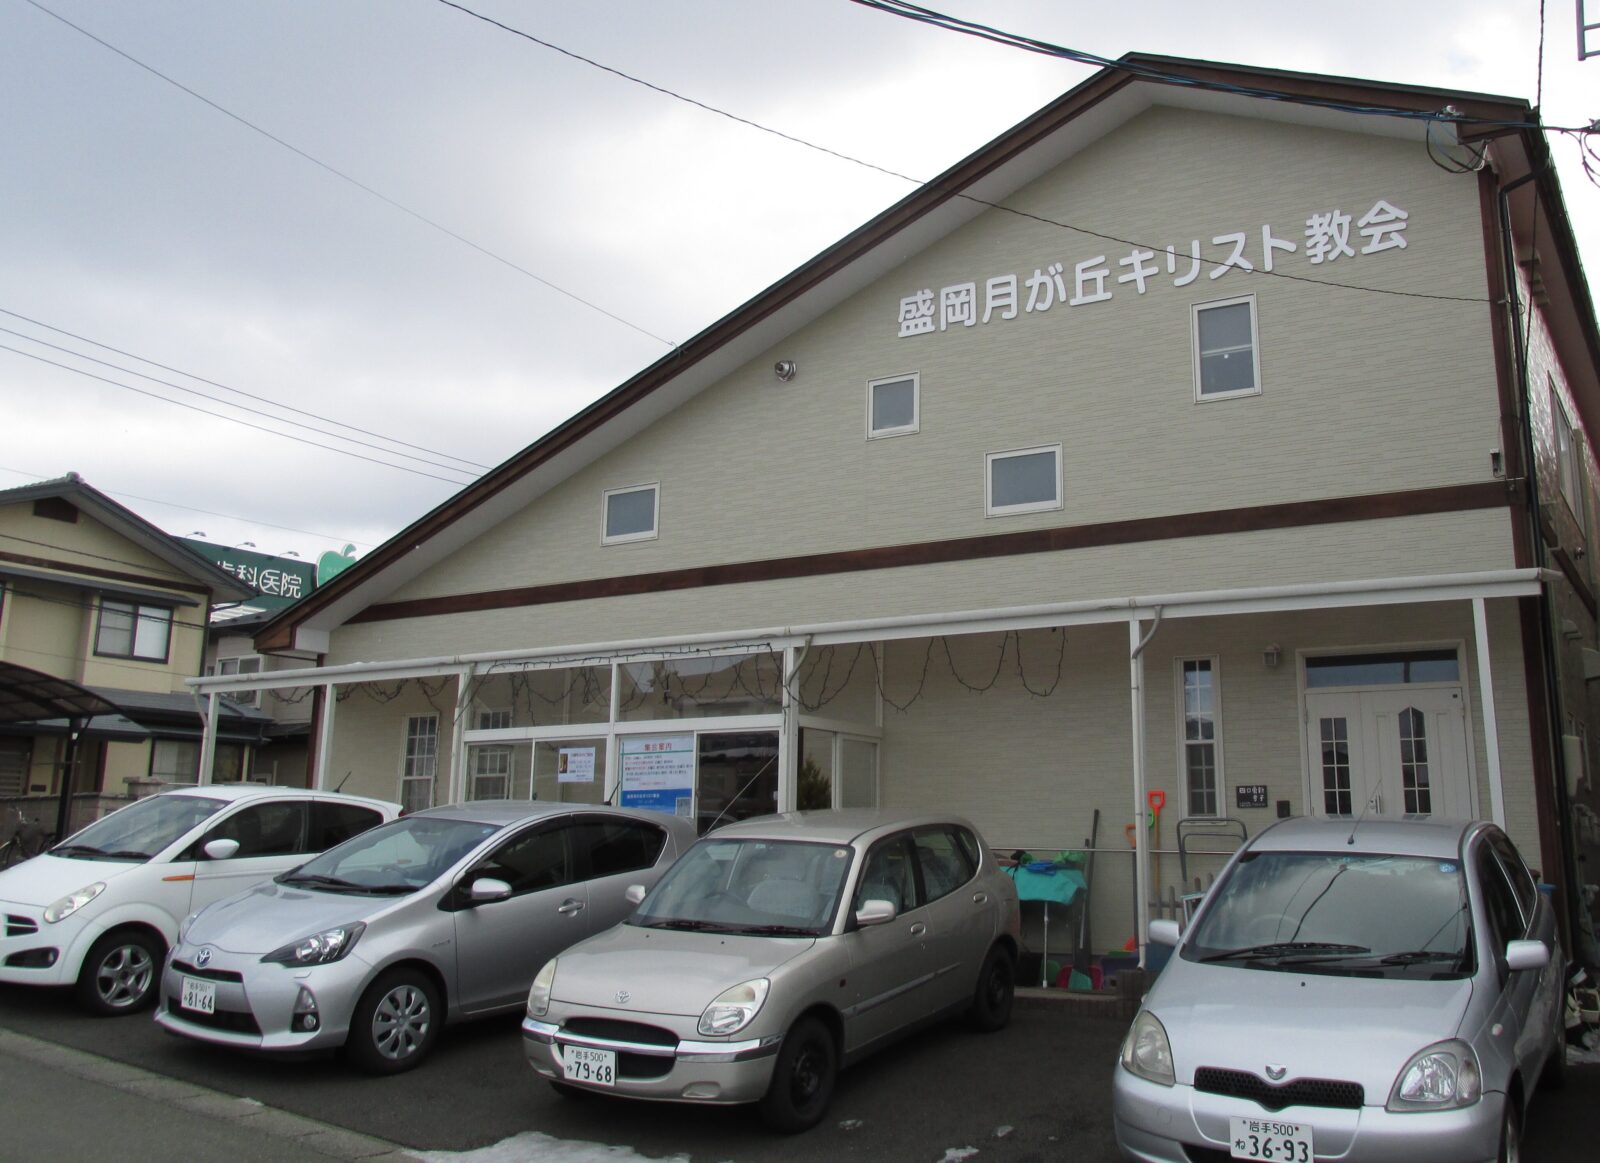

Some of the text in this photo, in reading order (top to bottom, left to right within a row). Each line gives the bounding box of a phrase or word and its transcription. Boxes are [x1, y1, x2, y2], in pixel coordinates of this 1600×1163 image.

[897, 199, 1409, 339] 盛岡月が丘キリスト教会
[574, 1060, 612, 1083] 79-68
[1235, 1134, 1309, 1163] ね 36-93
